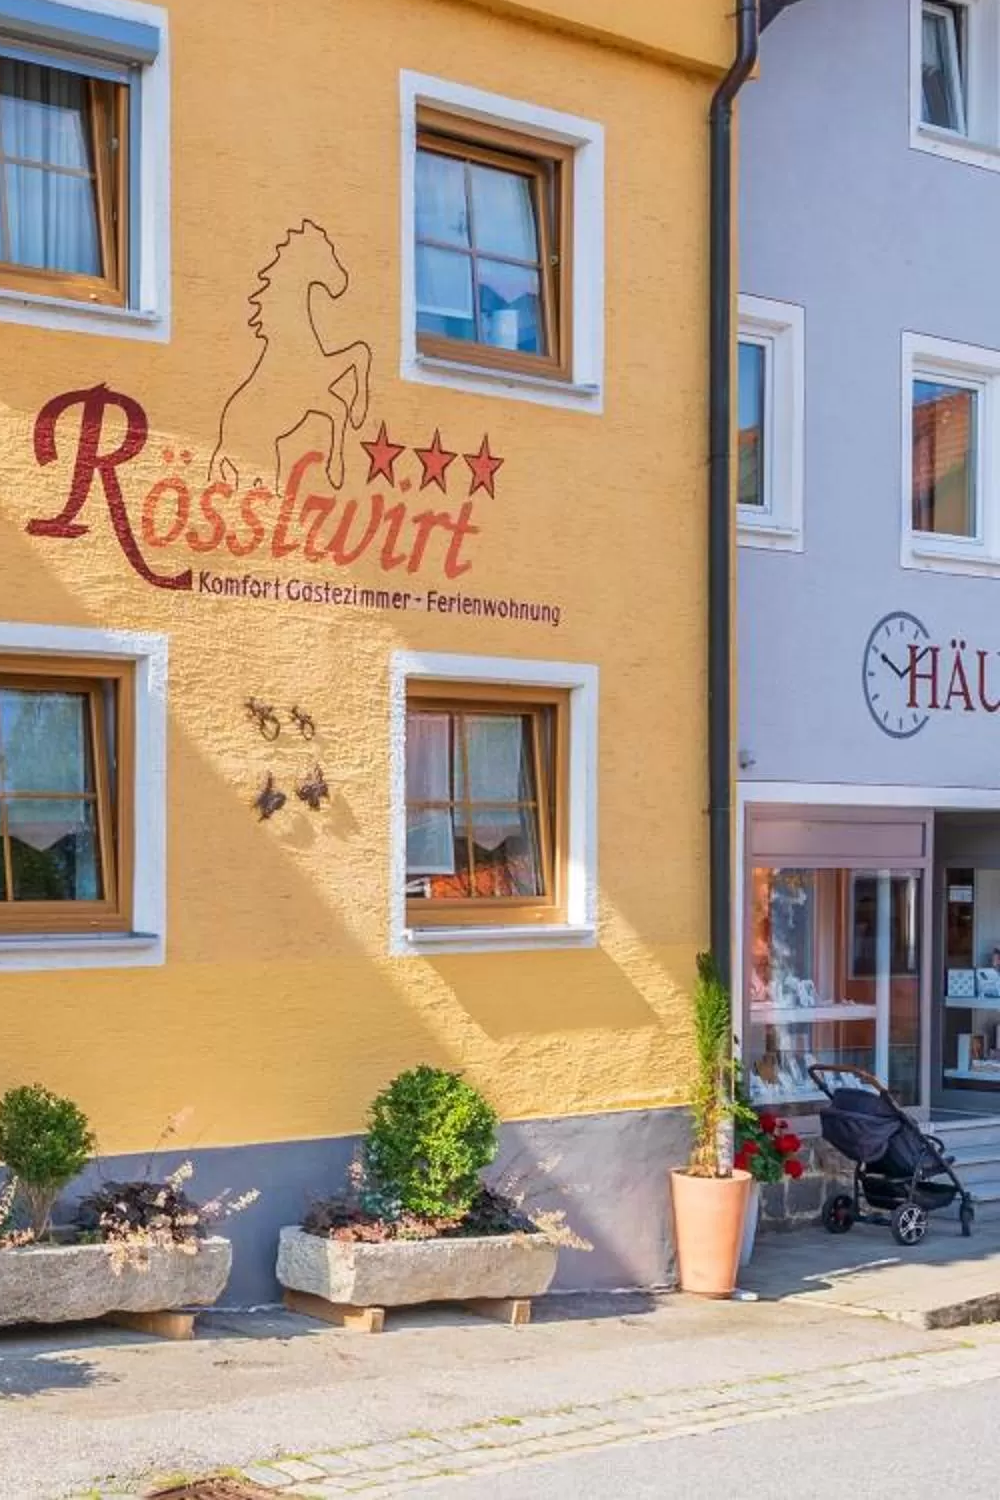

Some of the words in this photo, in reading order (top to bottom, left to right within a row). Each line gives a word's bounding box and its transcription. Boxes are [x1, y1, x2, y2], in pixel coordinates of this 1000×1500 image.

[24, 382, 480, 590] Rösslwirt
[199, 570, 281, 600] Komfort
[286, 578, 412, 610] Gästezimmer
[426, 589, 561, 627] Ferienwohnung
